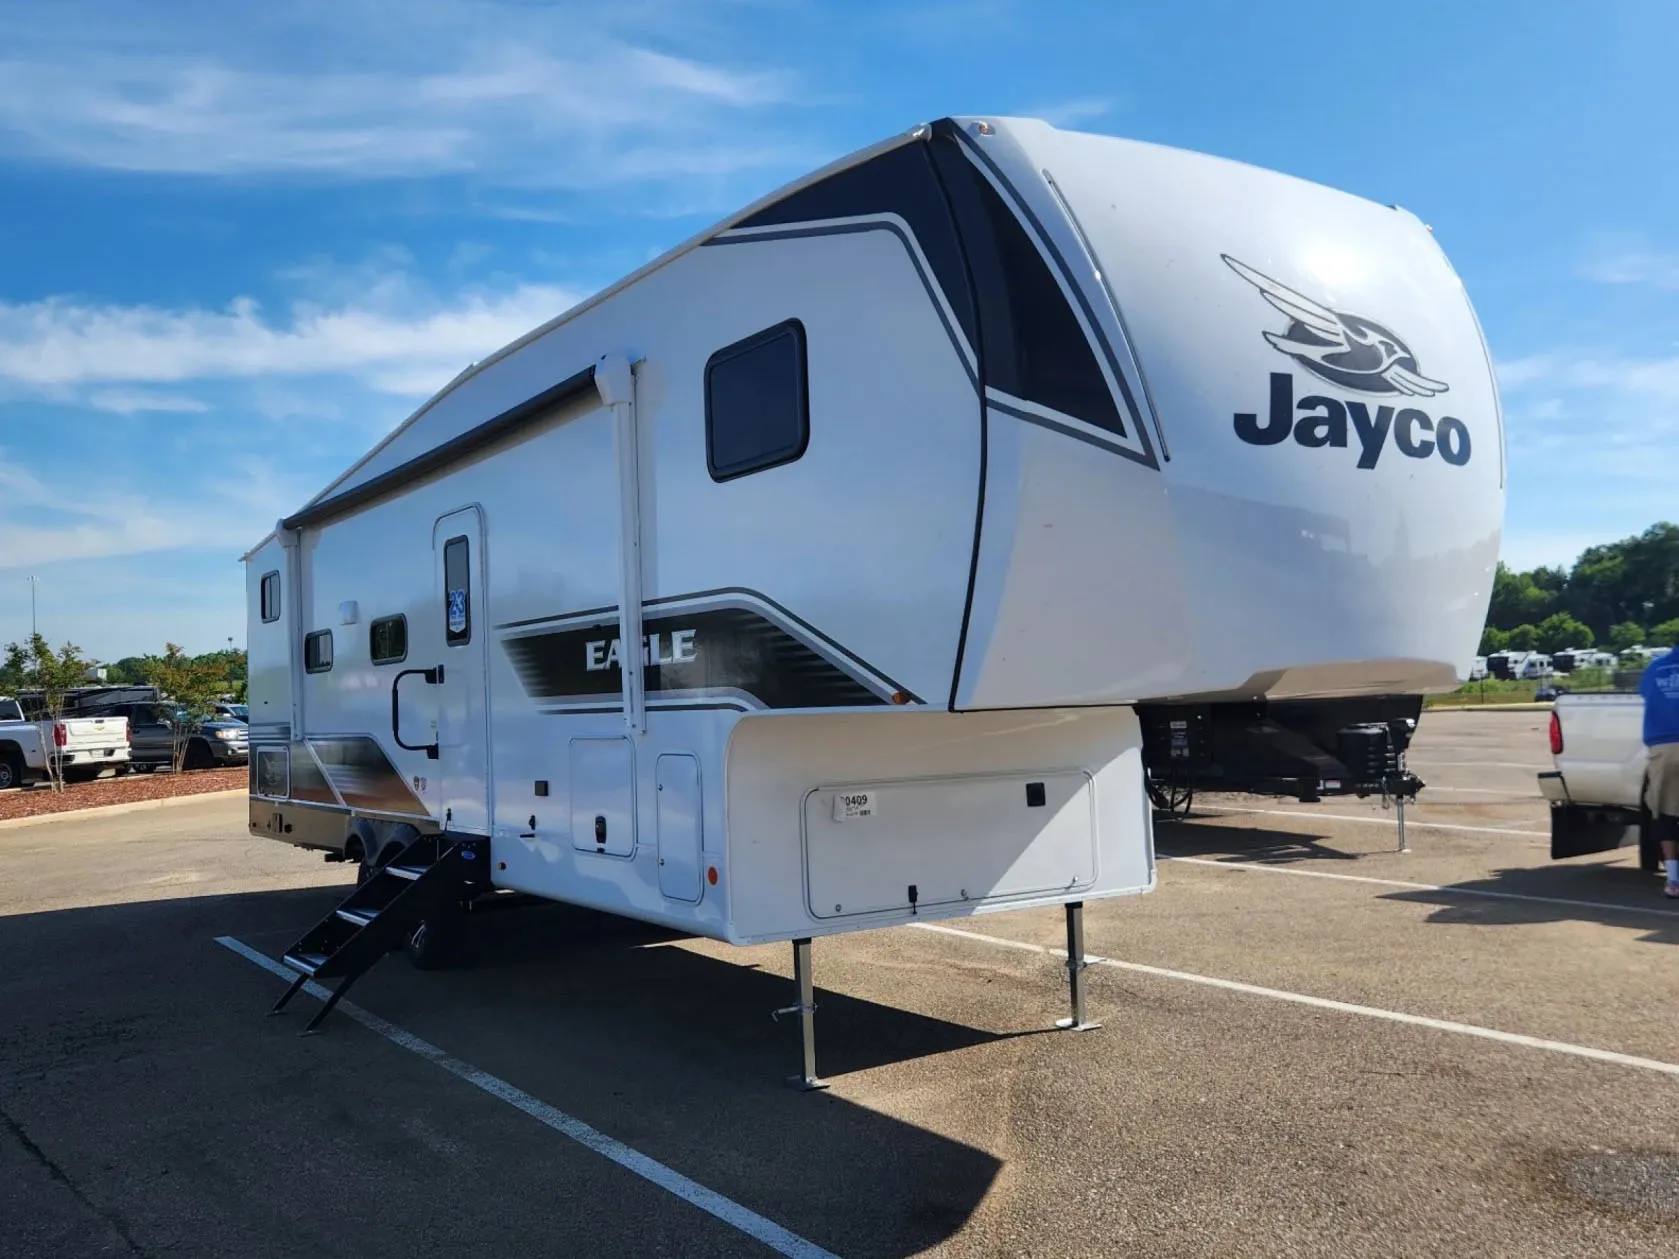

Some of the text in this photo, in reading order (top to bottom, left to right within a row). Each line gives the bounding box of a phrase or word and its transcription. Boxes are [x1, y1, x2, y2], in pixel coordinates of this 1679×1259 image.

[1233, 372, 1472, 470] Jayco
[585, 628, 698, 672] EALE
[840, 794, 868, 806] 0409
